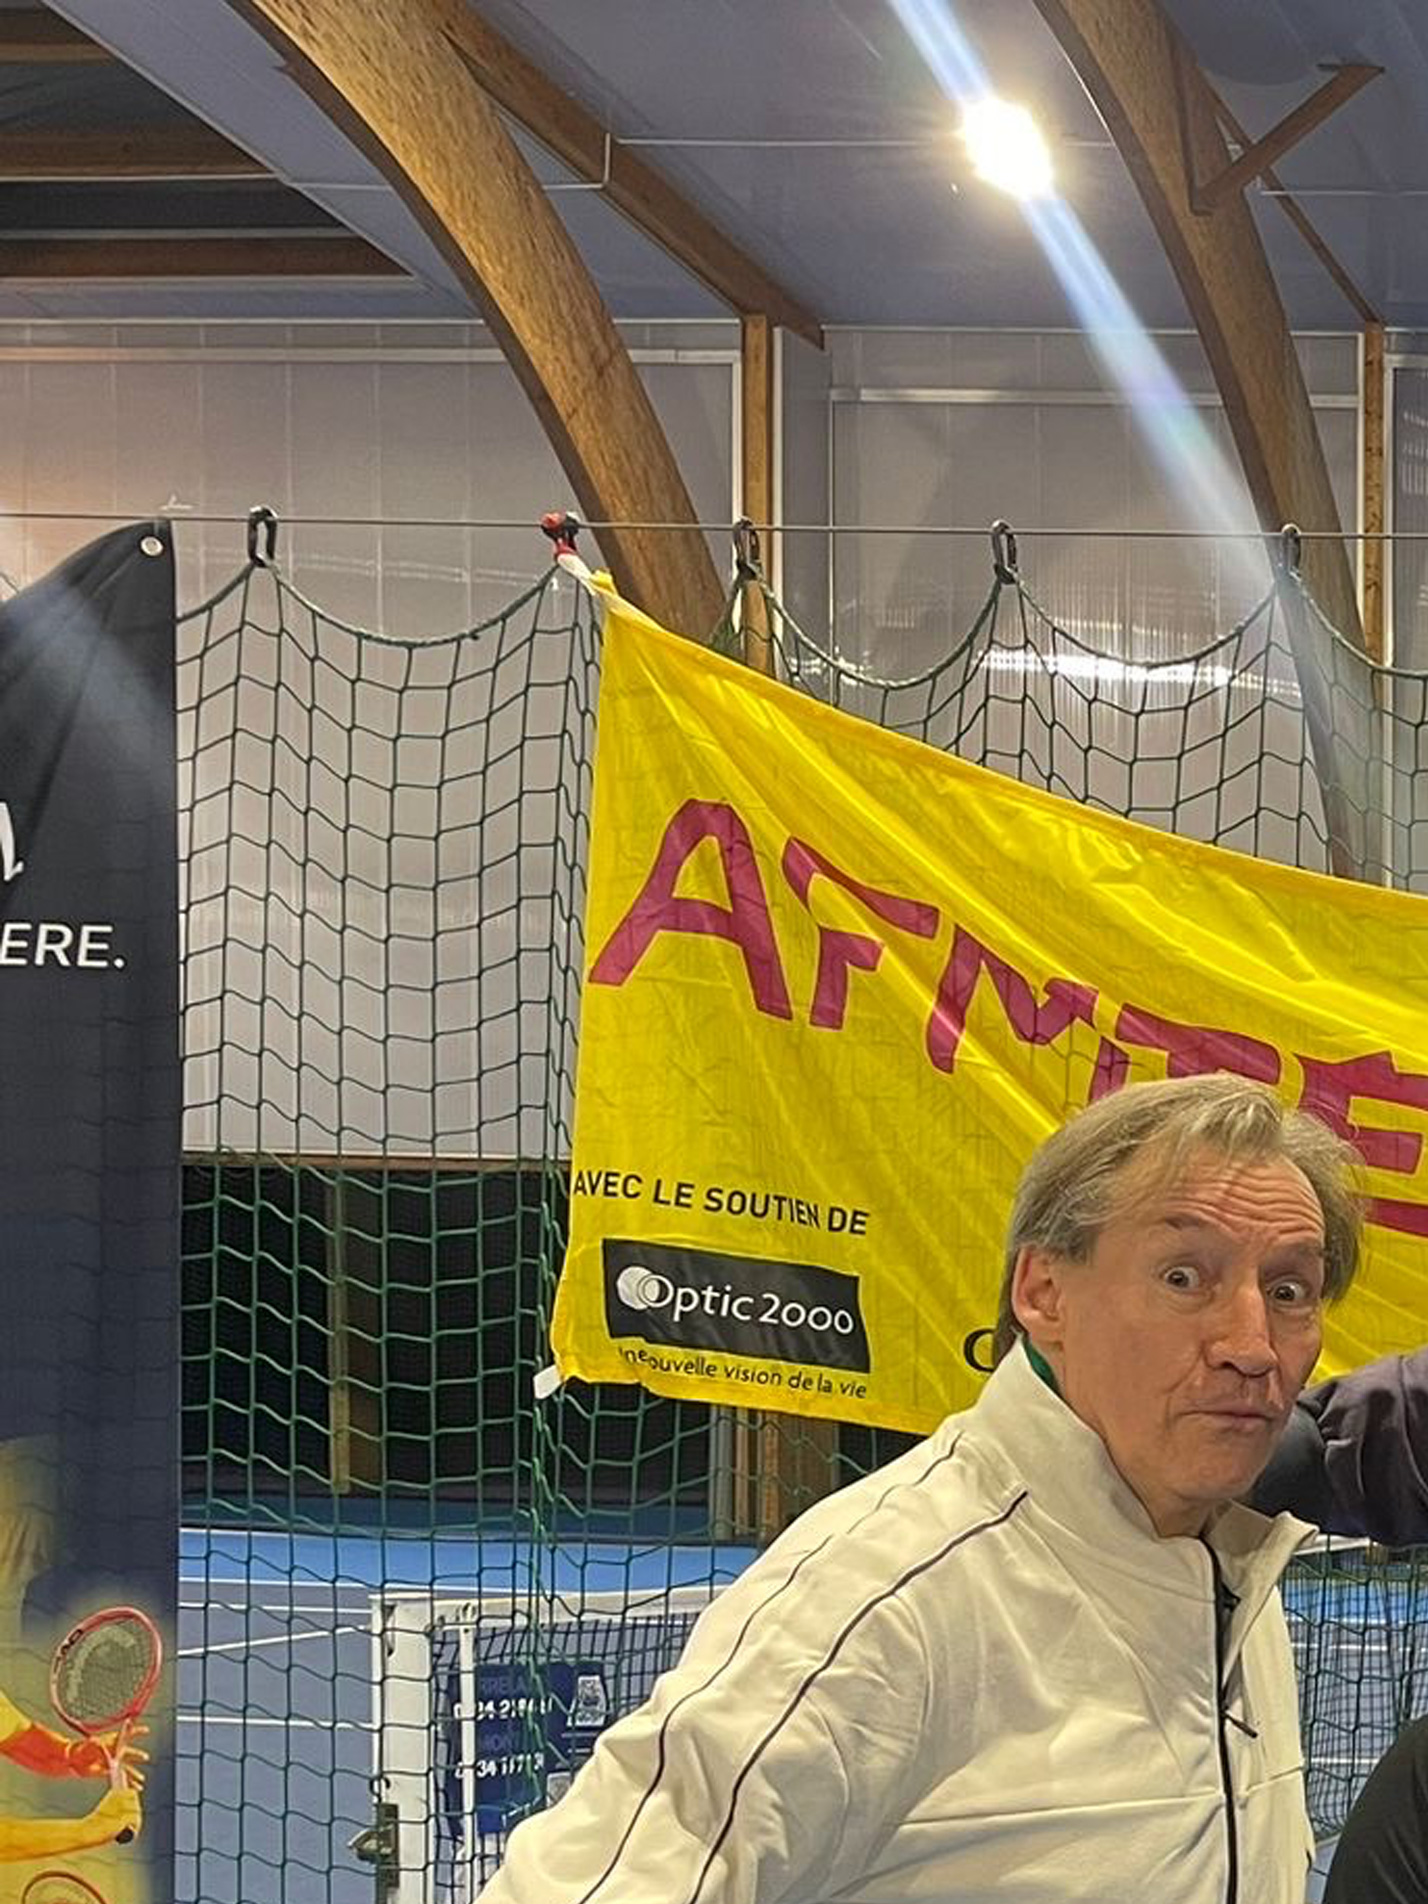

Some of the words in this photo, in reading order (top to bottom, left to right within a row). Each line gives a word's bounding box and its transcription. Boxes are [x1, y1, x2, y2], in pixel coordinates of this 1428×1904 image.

[573, 1170, 642, 1199] AVEC
[653, 1178, 694, 1209] LE
[703, 1187, 821, 1229] SOUTIEN
[827, 1206, 871, 1235] DE
[759, 1293, 854, 1335] 2000
[647, 1356, 717, 1379] ouvelle
[723, 1365, 782, 1388] vision
[788, 1371, 813, 1391] de
[816, 1373, 833, 1394] la
[839, 1382, 867, 1399] vie
